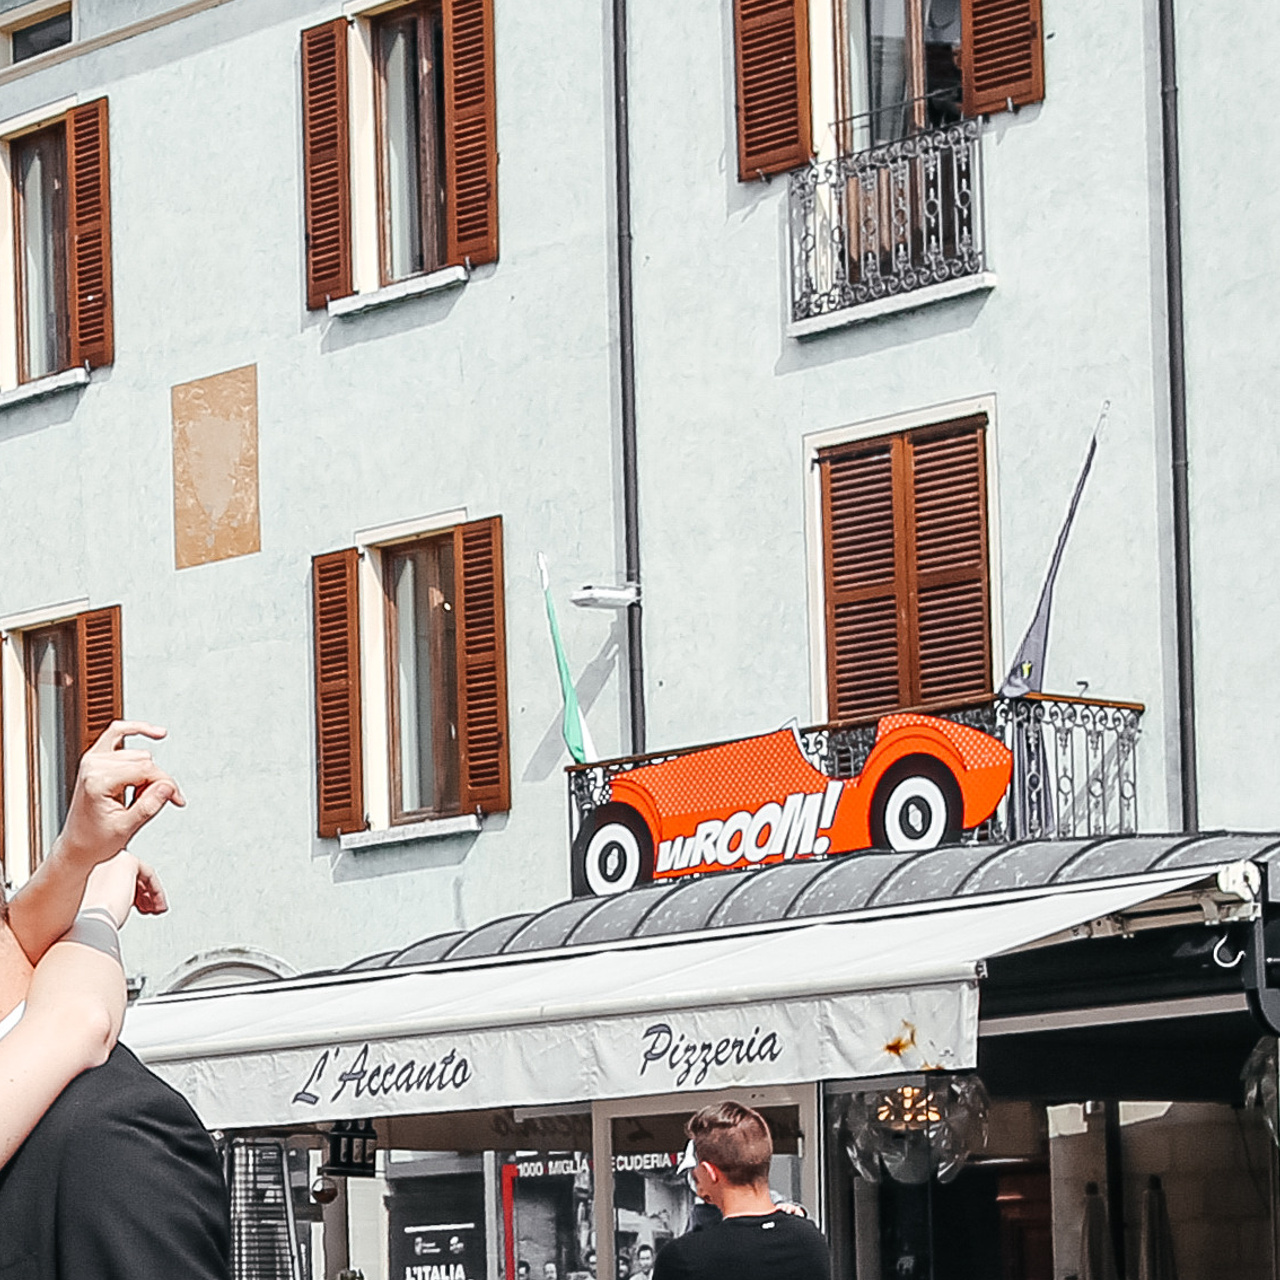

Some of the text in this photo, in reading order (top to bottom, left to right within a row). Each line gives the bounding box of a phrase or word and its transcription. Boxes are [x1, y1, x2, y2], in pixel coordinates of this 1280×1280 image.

[291, 1023, 783, 1104] L'Accanto Pizzeria
[517, 1162, 544, 1177] 1000
[548, 1160, 590, 1175] MIGLIA
